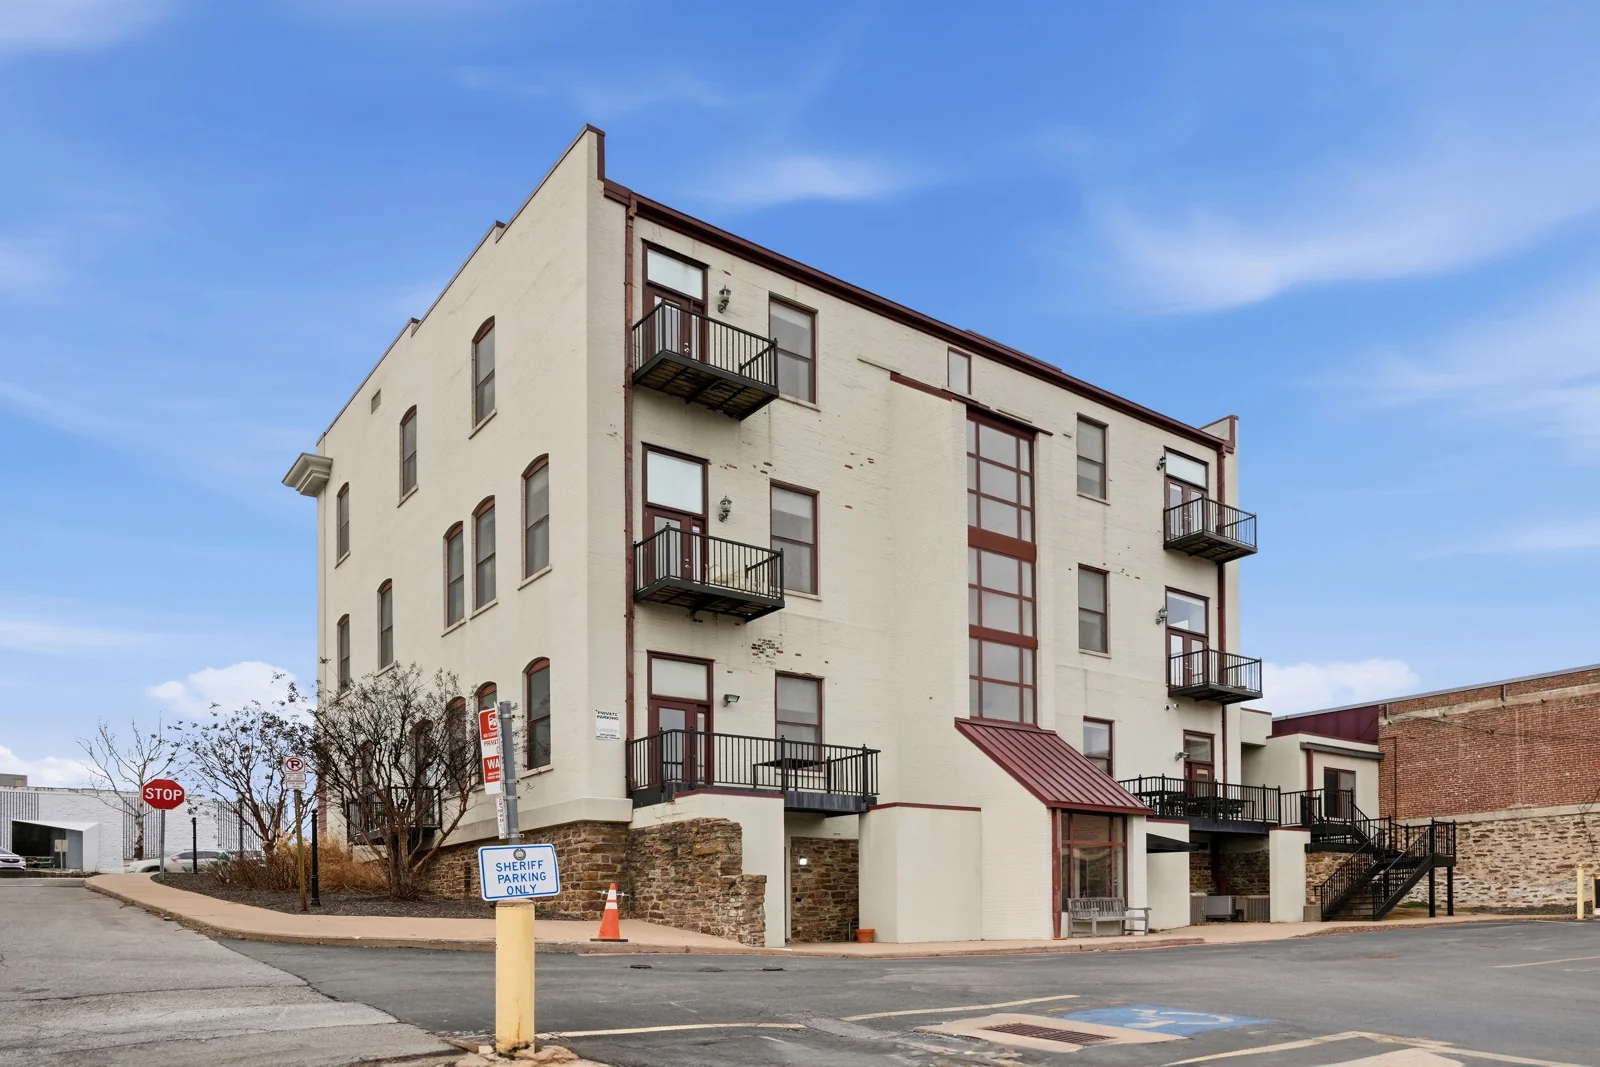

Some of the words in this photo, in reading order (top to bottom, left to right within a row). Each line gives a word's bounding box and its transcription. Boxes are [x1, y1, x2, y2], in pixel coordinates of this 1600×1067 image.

[484, 738, 499, 747] PRIVAT
[487, 758, 500, 769] WA
[145, 787, 182, 801] STOP
[495, 860, 543, 872] SHERIFF
[497, 872, 546, 884] PARKING
[506, 884, 537, 895] ONLY
